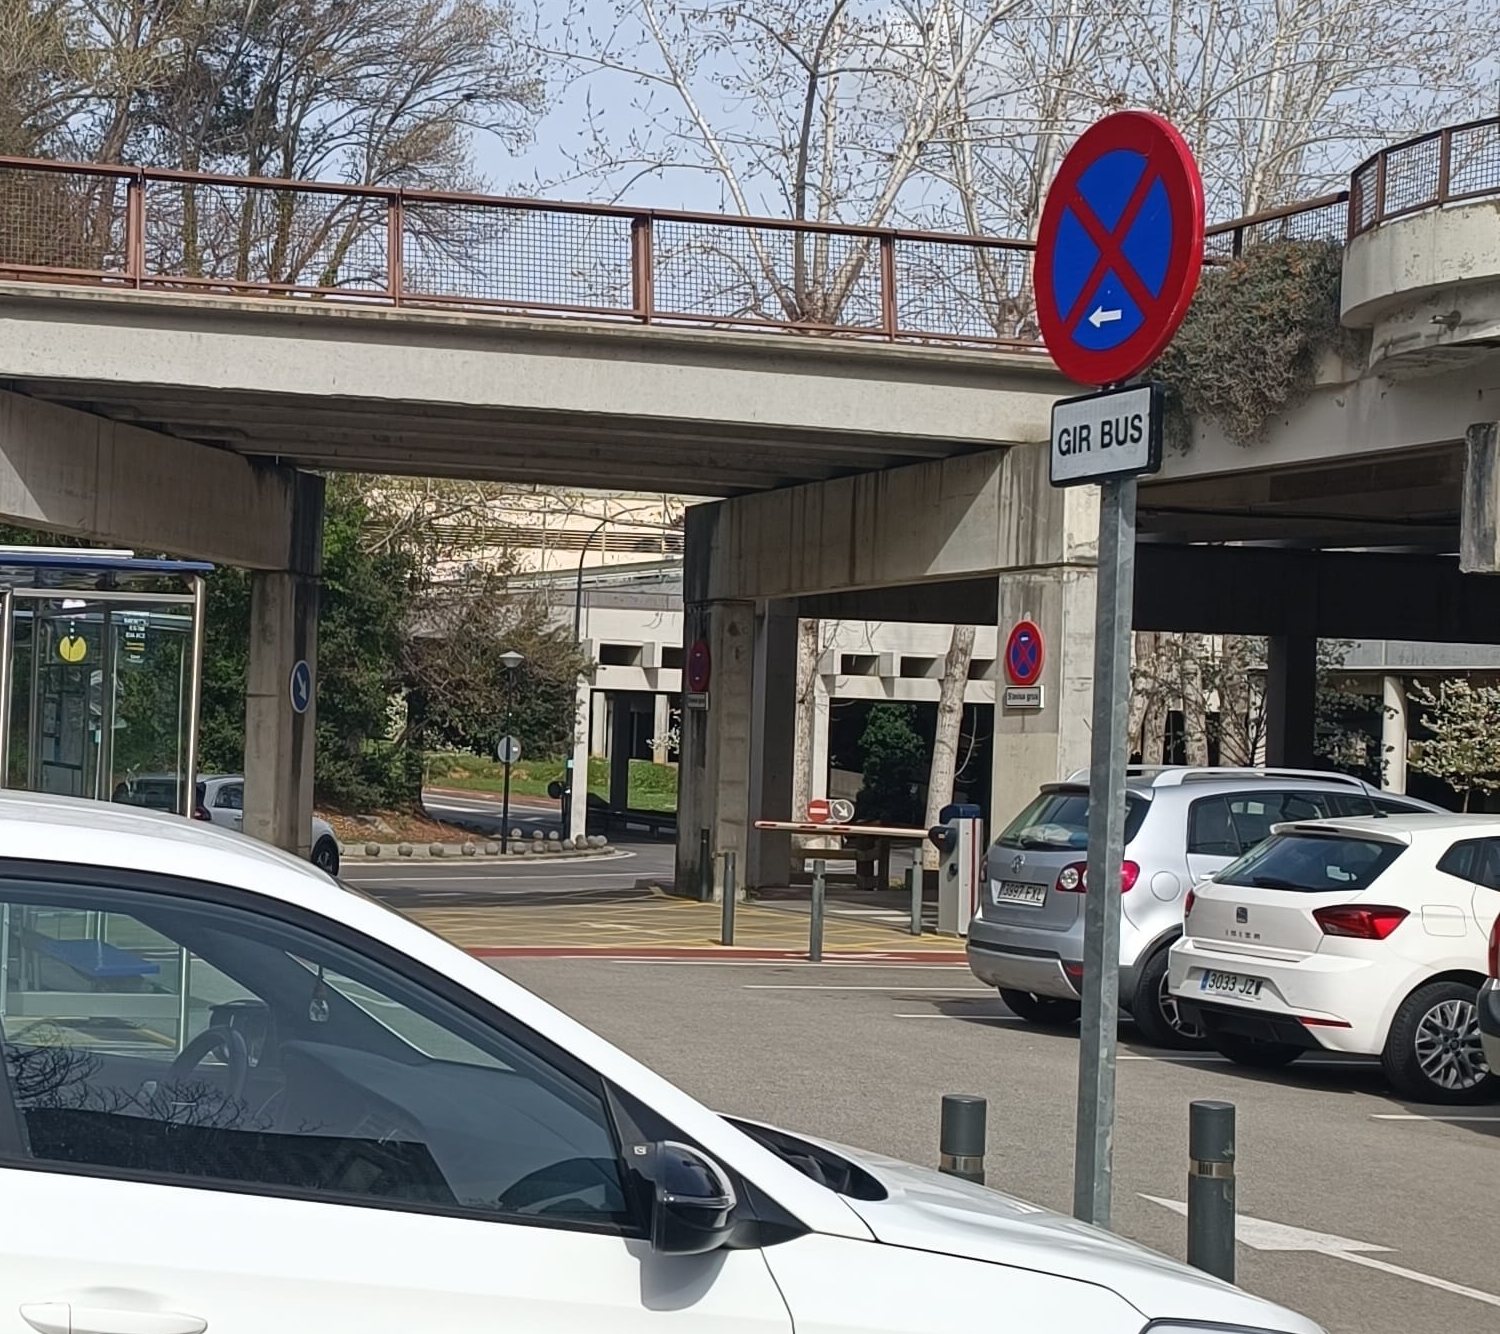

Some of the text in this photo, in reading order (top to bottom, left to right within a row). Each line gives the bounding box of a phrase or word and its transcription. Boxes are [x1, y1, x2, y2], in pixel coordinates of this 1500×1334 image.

[1058, 414, 1143, 457] GIR BUS
[1208, 973, 1238, 992] 3033
